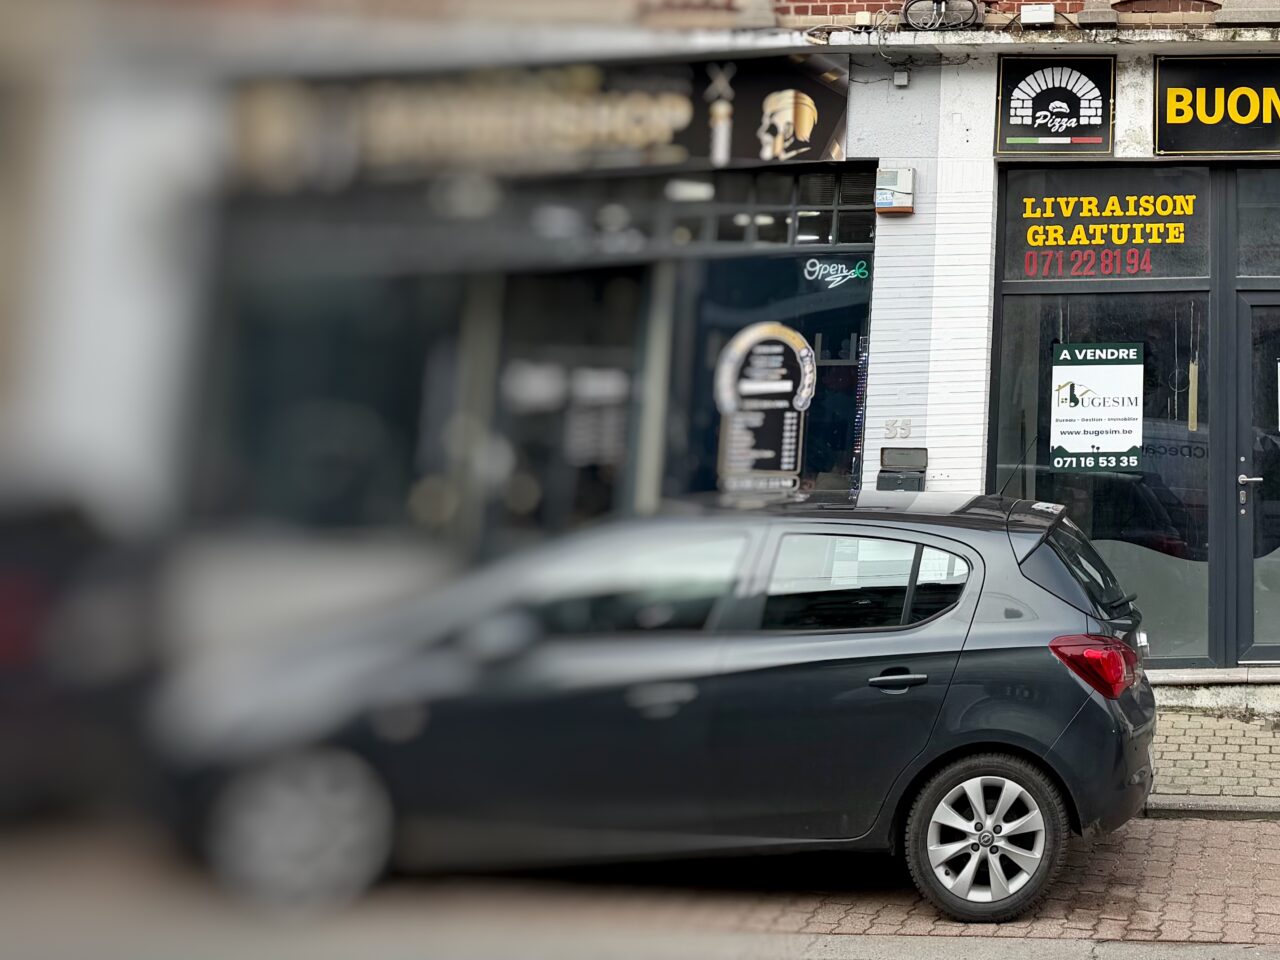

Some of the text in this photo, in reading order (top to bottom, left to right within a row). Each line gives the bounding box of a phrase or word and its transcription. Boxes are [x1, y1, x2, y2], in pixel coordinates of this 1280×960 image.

[1034, 110, 1078, 132] Pizza
[1022, 194, 1197, 218] LIVRAISON
[1026, 222, 1185, 247] GRATUITE
[804, 258, 848, 280] Open
[1024, 249, 1065, 278] 071
[1059, 348, 1138, 360] A VENDRE
[884, 418, 912, 439] 35
[1060, 428, 1133, 437] www.bugesim.be
[1053, 456, 1138, 468] 071 16 53 35
